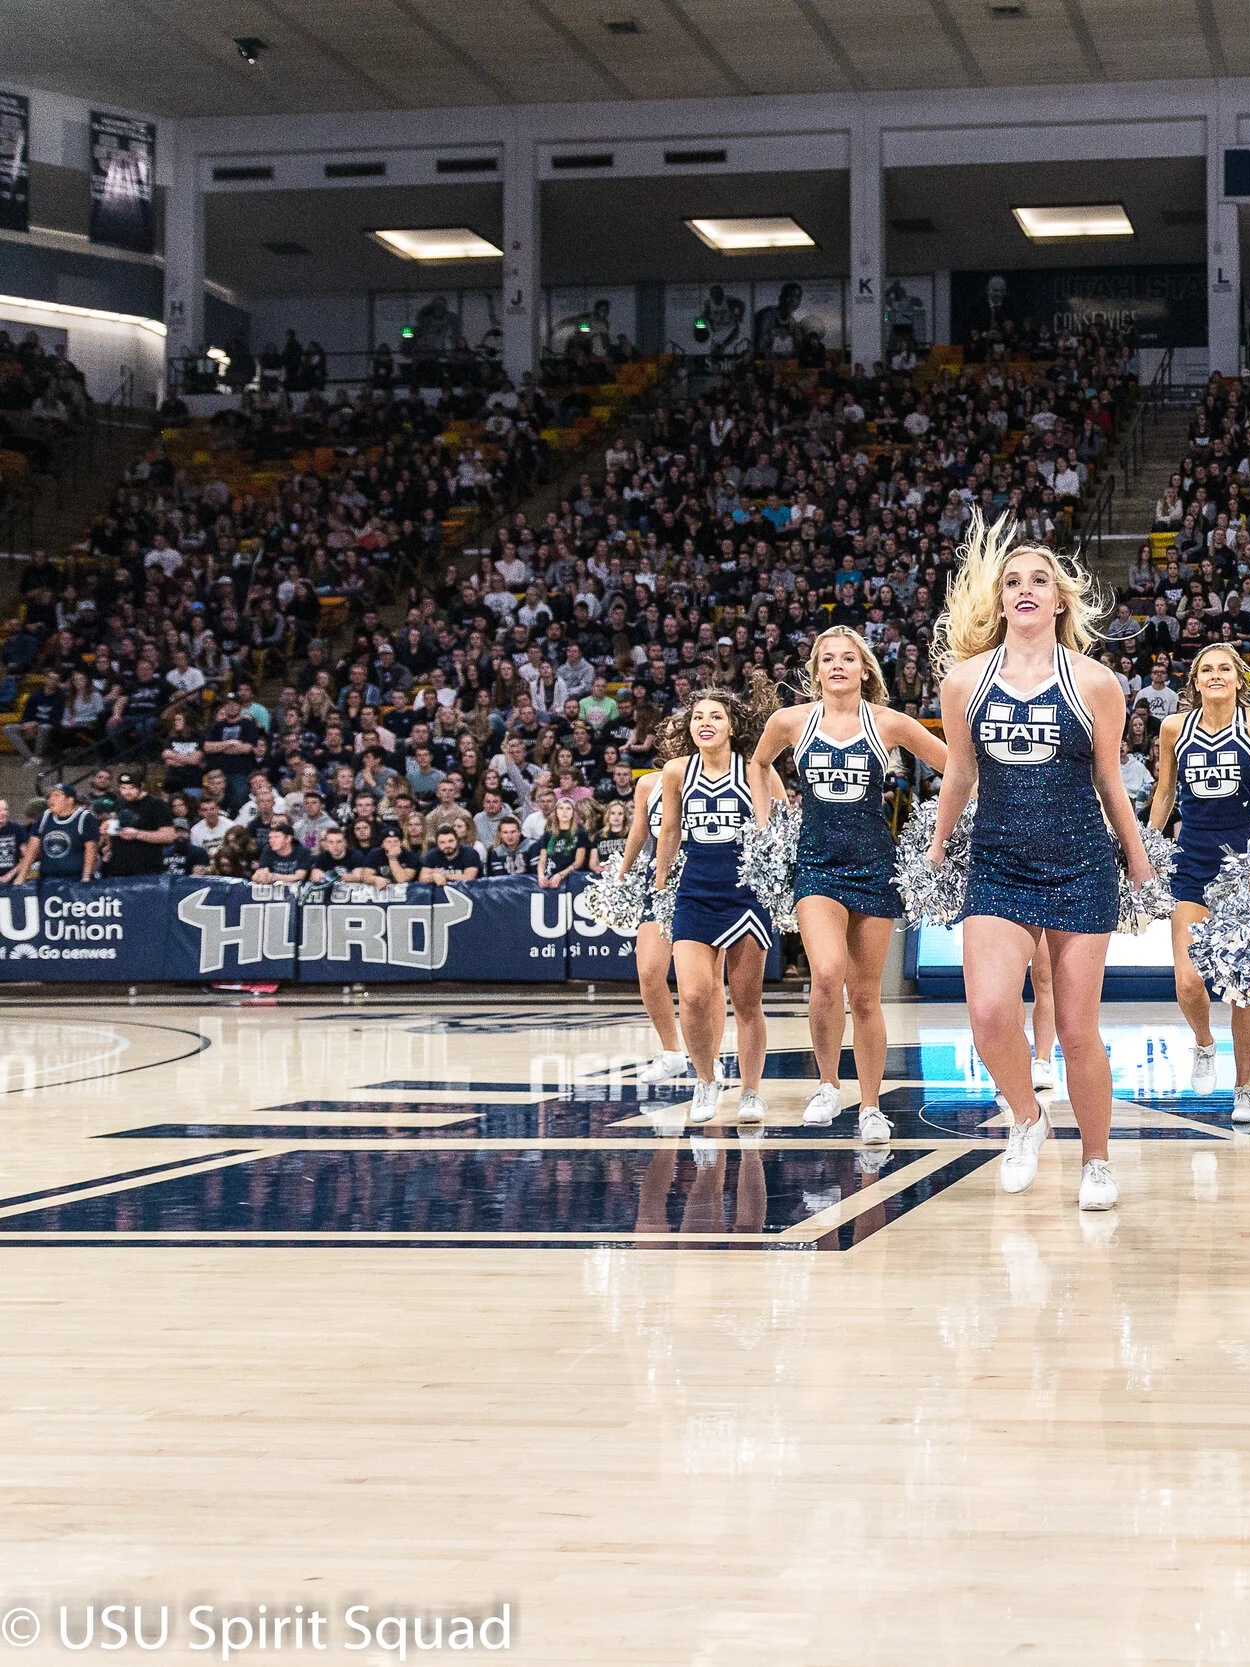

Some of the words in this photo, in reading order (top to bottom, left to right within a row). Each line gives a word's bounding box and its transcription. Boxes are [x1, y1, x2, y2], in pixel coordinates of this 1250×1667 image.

[858, 277, 873, 295] K
[1217, 267, 1231, 284] L
[510, 289, 523, 306] J
[170, 300, 184, 317] H
[979, 720, 1060, 746] STATE
[805, 766, 871, 787] STATE
[1184, 763, 1243, 786] STATE
[686, 811, 741, 829] STATE
[44, 895, 123, 918] Credit
[531, 891, 639, 938] US
[44, 919, 124, 941] Union
[178, 886, 473, 973] HURD
